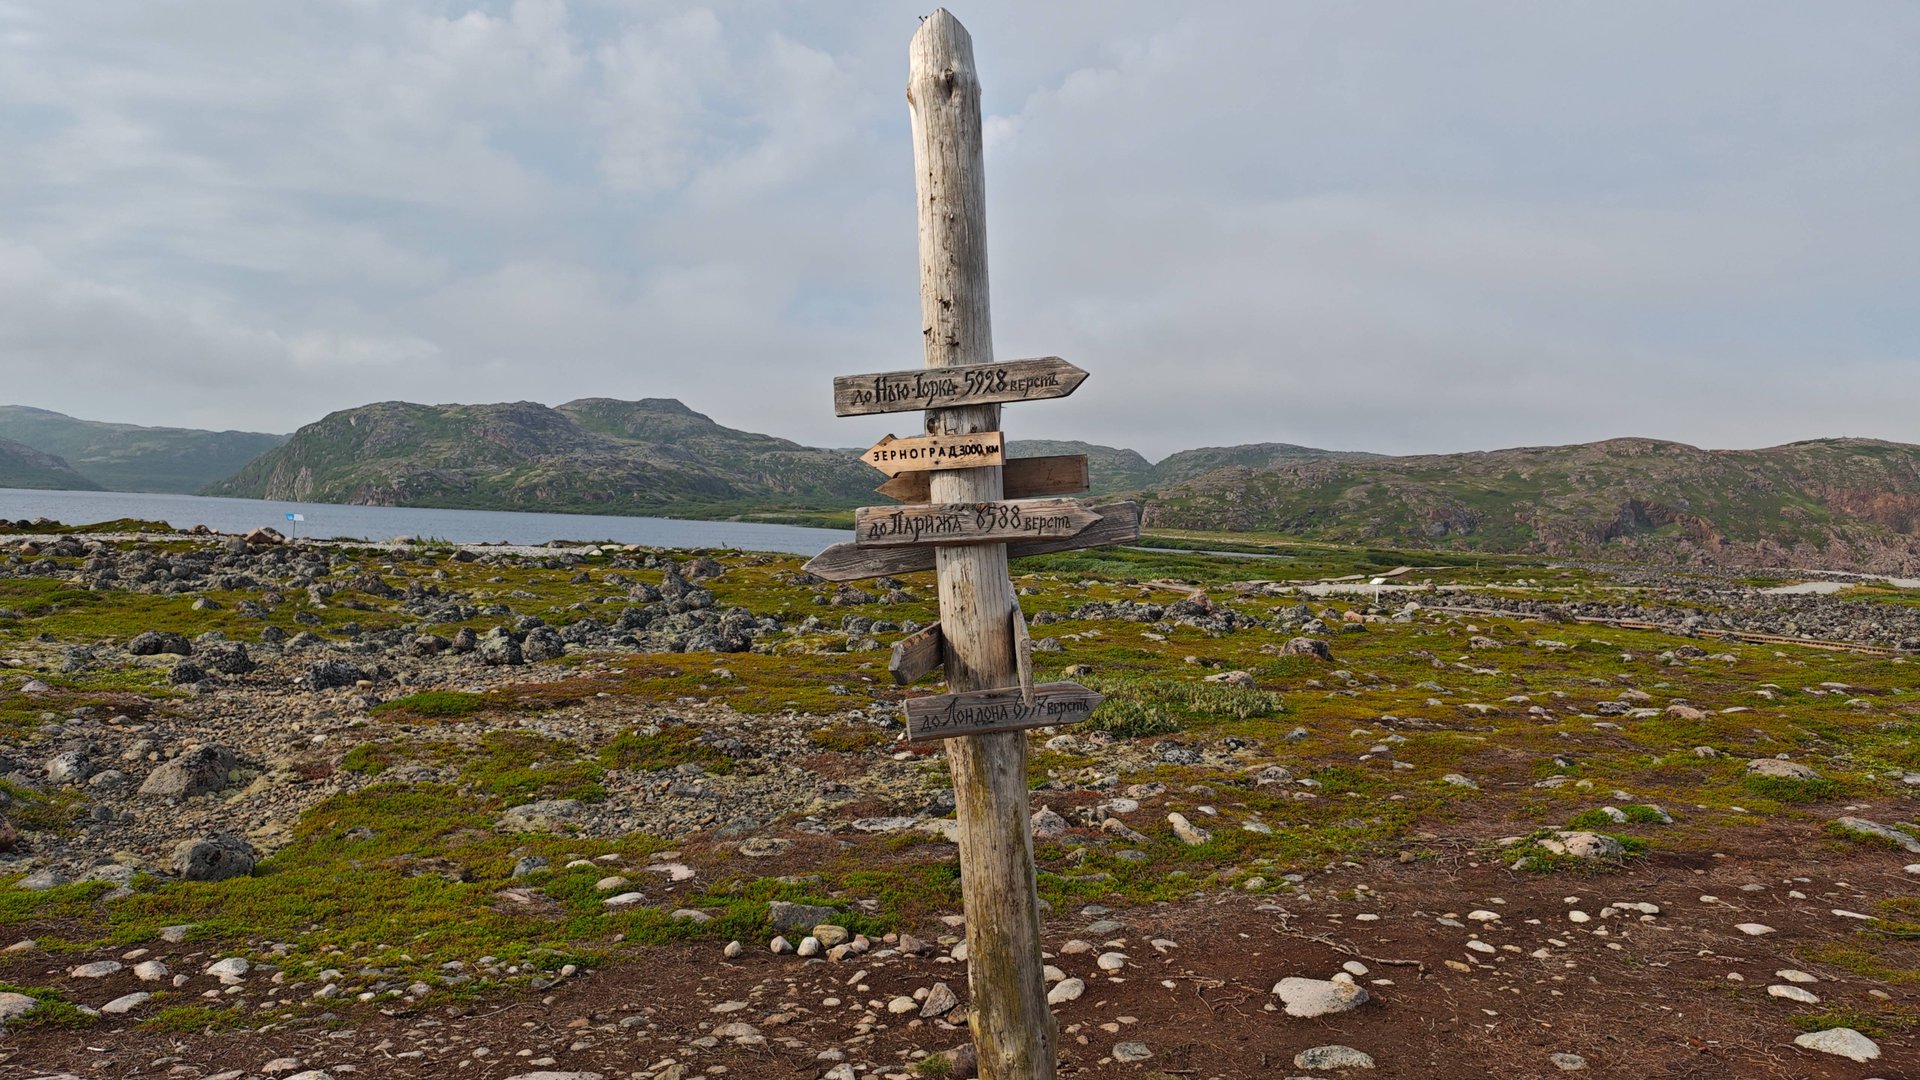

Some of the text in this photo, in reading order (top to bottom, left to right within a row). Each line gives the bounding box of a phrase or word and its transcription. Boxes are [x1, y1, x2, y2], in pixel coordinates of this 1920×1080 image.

[852, 389, 872, 406] до
[961, 368, 1008, 398] 5928
[873, 445, 957, 462] ЗЕРНОГРАД
[959, 443, 983, 456] 3000
[869, 521, 887, 539] до
[920, 714, 941, 732] до
[942, 696, 1008, 727] Лондона
